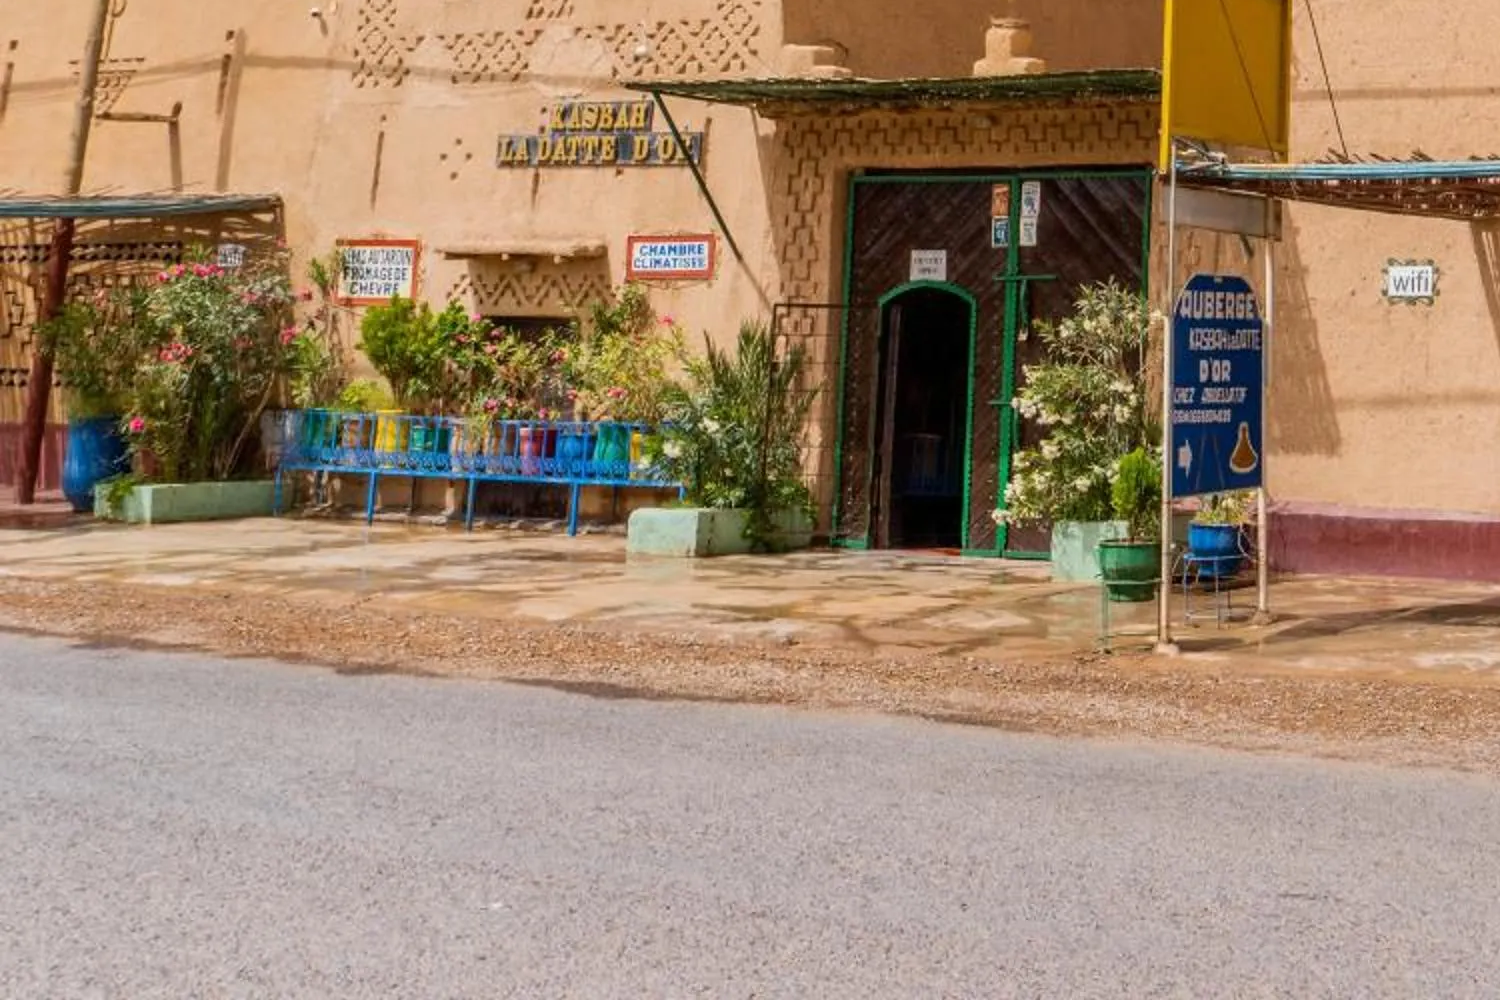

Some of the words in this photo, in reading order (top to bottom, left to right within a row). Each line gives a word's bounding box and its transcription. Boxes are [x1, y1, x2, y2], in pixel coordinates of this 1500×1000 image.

[550, 102, 646, 130] KASBAH
[500, 136, 529, 162] LA
[538, 135, 617, 162] DATTE
[640, 243, 705, 257] CHAMBRE
[1180, 289, 1255, 319] AUBERGE
[1199, 357, 1231, 383] D'OR
